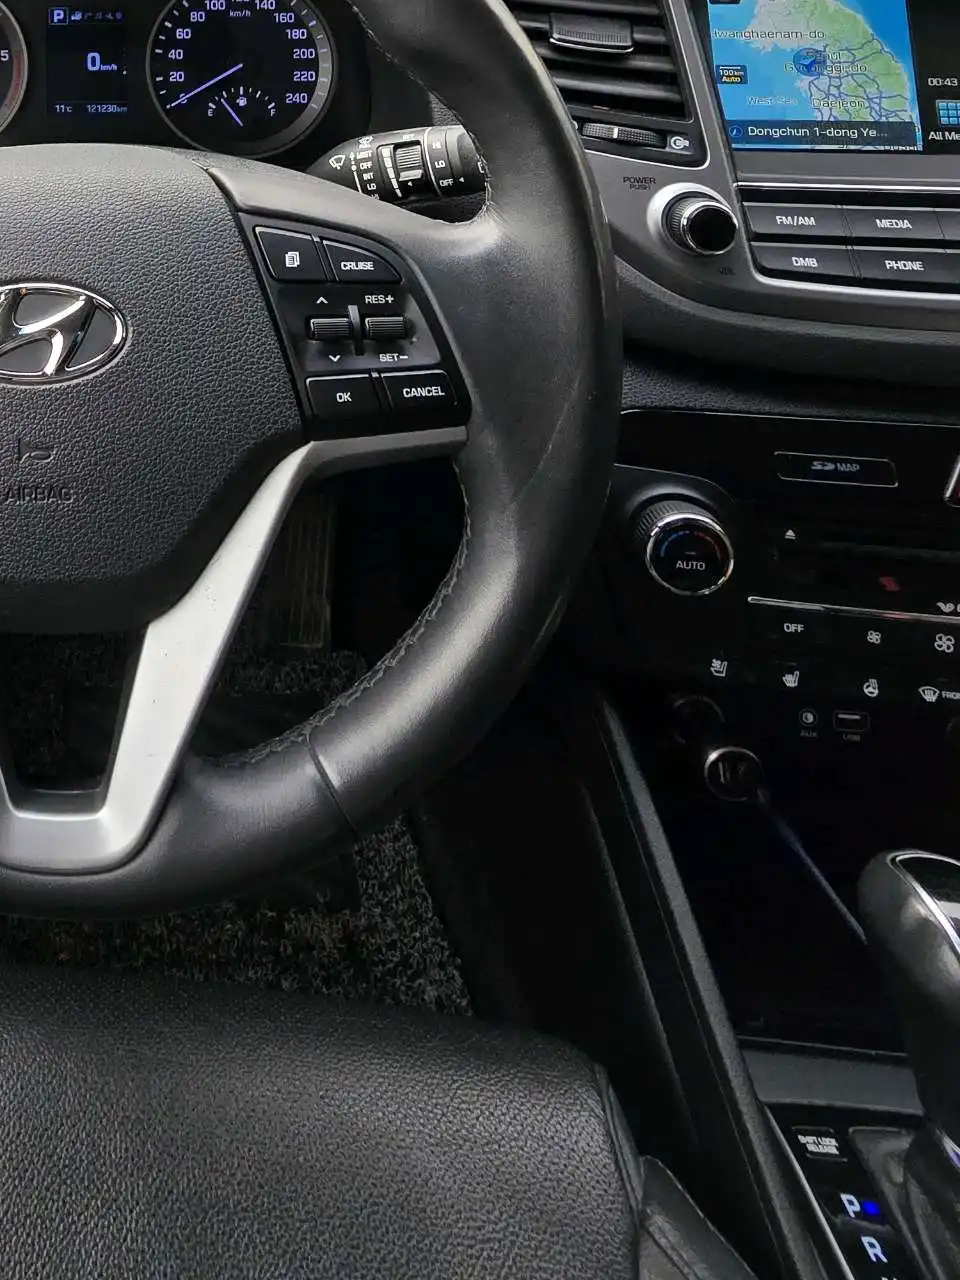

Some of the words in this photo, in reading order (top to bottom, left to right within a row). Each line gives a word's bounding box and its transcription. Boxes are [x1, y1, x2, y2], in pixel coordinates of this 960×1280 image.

[205, 0, 226, 10] 100
[255, 0, 276, 10] 140
[54, 10, 64, 22] P
[190, 12, 205, 22] 80
[229, 9, 251, 17] km/h
[274, 13, 294, 23] 160
[176, 29, 191, 39] 60
[286, 29, 307, 39] 180
[0, 50, 9, 61] 5
[168, 49, 183, 59] 40
[293, 49, 315, 59] 200
[87, 52, 100, 71] 0
[169, 72, 184, 82] 20
[293, 72, 315, 81] 220
[928, 78, 958, 86] 00:43
[285, 93, 307, 103] 240
[812, 98, 866, 109] Daejeon
[749, 127, 809, 138] Dongchun
[814, 127, 857, 138] 1-dong
[929, 131, 943, 141] All
[360, 162, 373, 170] OFF
[435, 160, 445, 168] LO
[363, 172, 374, 180] INT
[623, 176, 656, 185] POWER
[440, 178, 453, 187] OFF
[776, 216, 815, 227] FM/AM
[876, 219, 912, 230] MEDIA
[341, 261, 374, 270] CRUISE
[792, 257, 818, 268] DMB
[885, 260, 924, 272] PHONE
[365, 295, 394, 304] RES+
[336, 392, 352, 402] OK
[403, 386, 445, 398] CANCEL
[837, 463, 860, 472] MAP
[5, 485, 75, 504] AIRBAG
[676, 560, 706, 571] AUTO
[783, 622, 804, 633] OFF
[840, 1193, 860, 1218] P
[860, 1235, 889, 1263] R
